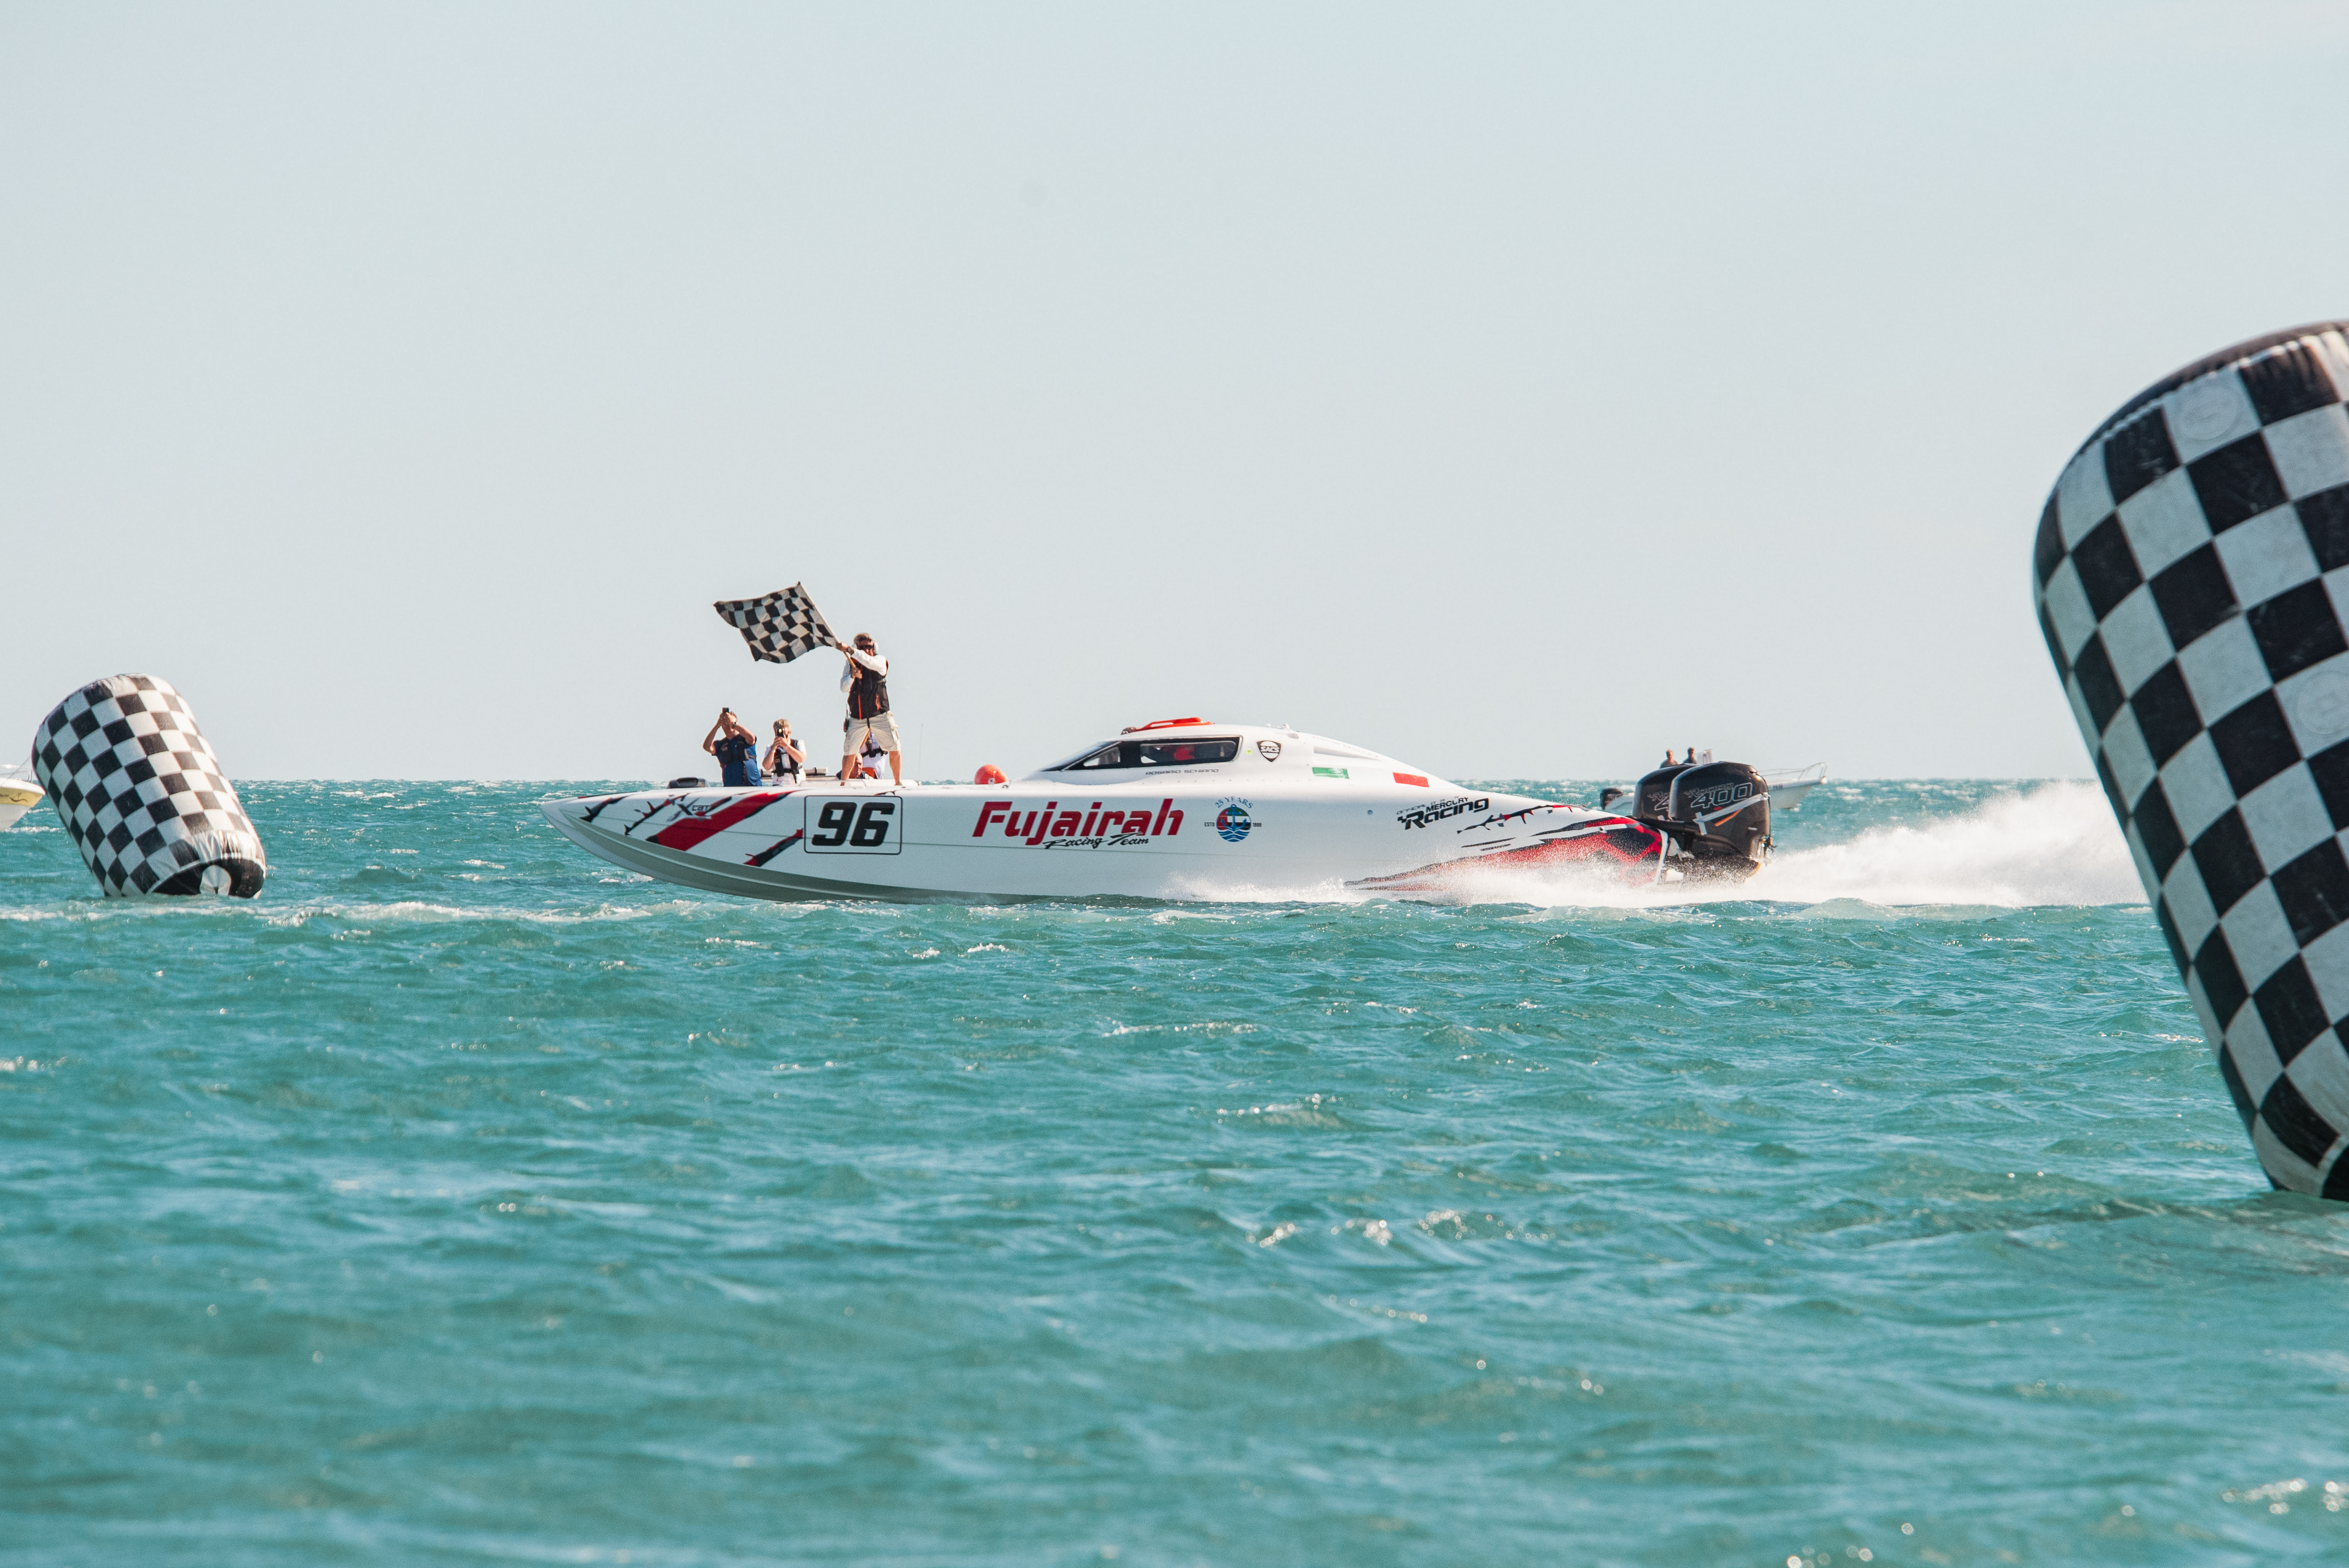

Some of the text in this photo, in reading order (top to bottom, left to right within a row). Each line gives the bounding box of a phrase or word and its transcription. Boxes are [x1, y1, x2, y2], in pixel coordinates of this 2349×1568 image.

[1215, 796, 1253, 808] 25 YEARS
[1426, 797, 1468, 813] MERCURY
[1691, 782, 1753, 809] 400
[812, 801, 895, 847] 96
[972, 798, 1184, 846] Fujairah
[1404, 798, 1490, 830] Racing
[1042, 832, 1149, 849] Racing Team
